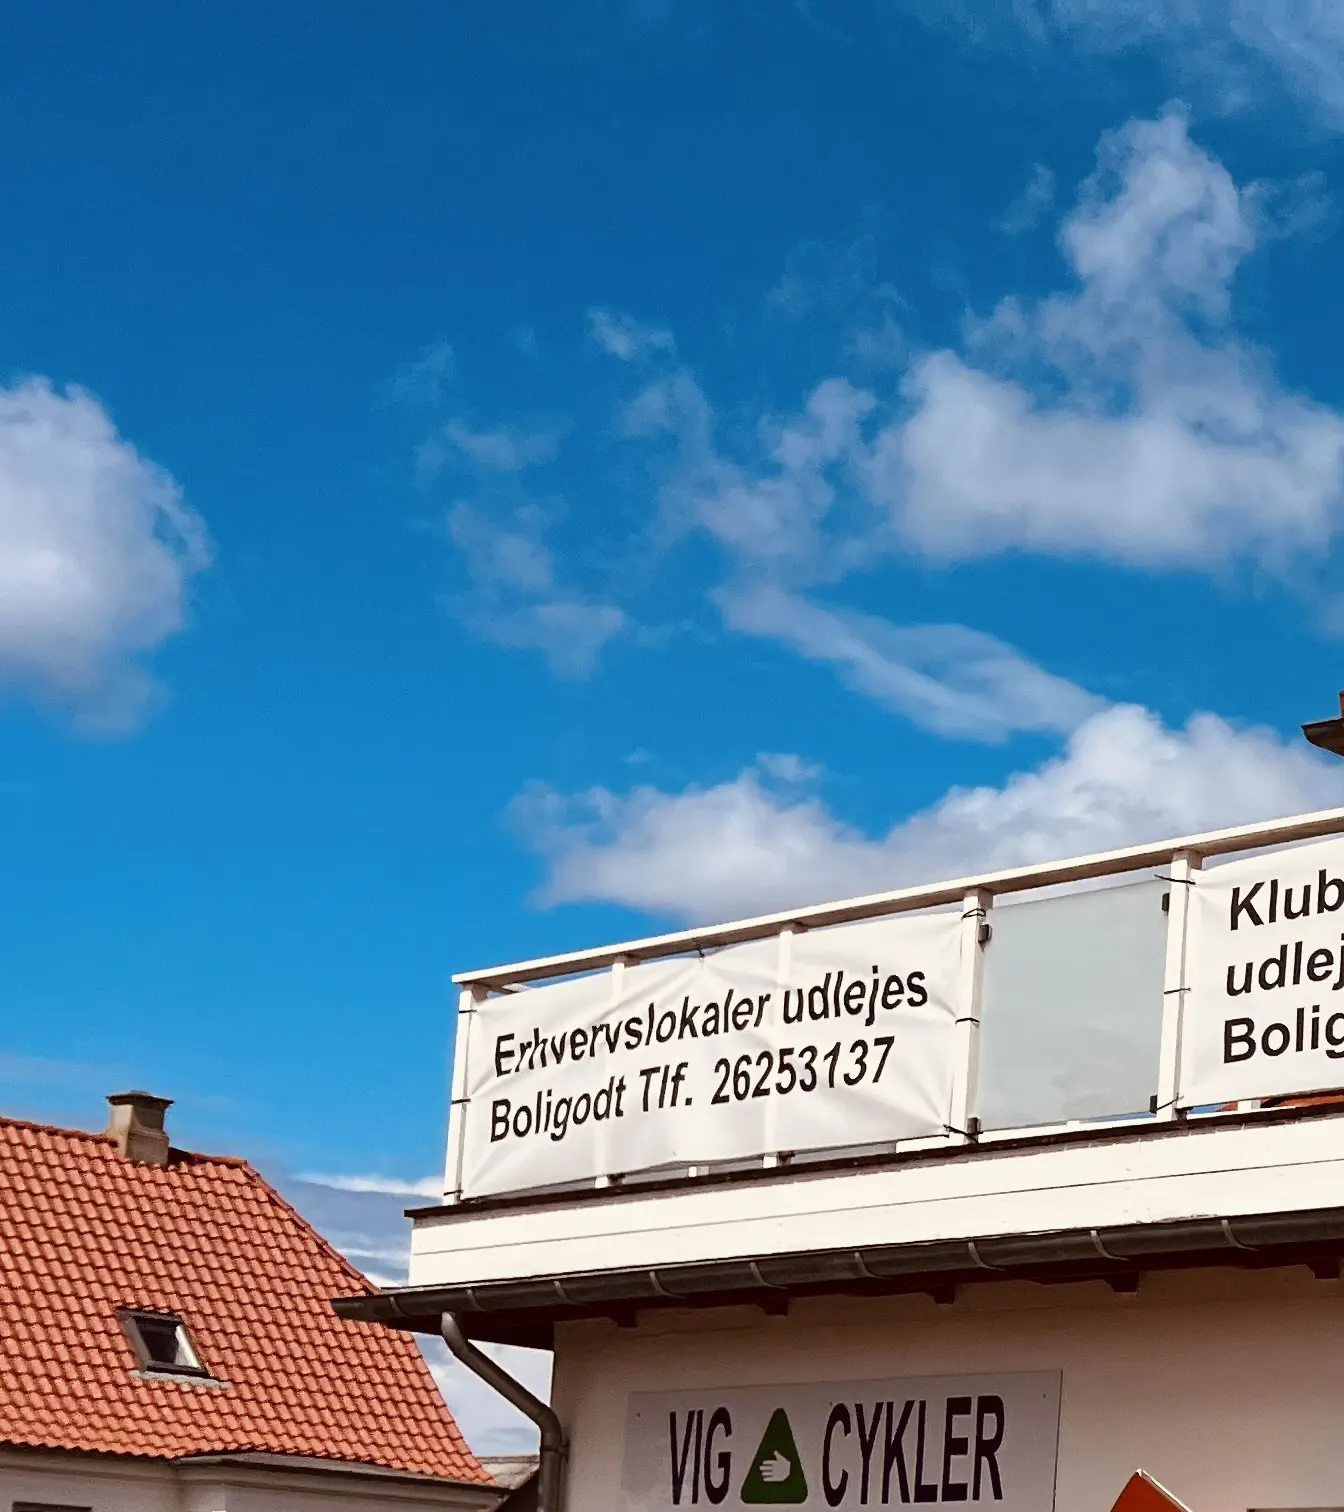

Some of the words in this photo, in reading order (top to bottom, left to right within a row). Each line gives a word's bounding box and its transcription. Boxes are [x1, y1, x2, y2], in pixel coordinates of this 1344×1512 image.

[493, 990, 770, 1077] Erhvervslokaler
[783, 965, 928, 1027] udlejes
[490, 1075, 627, 1143] Boligodt
[639, 1062, 693, 1112] Tlf.
[710, 1035, 895, 1105] 26253137
[669, 1407, 733, 1506] VIG
[822, 1395, 1005, 1507] CYKLER
